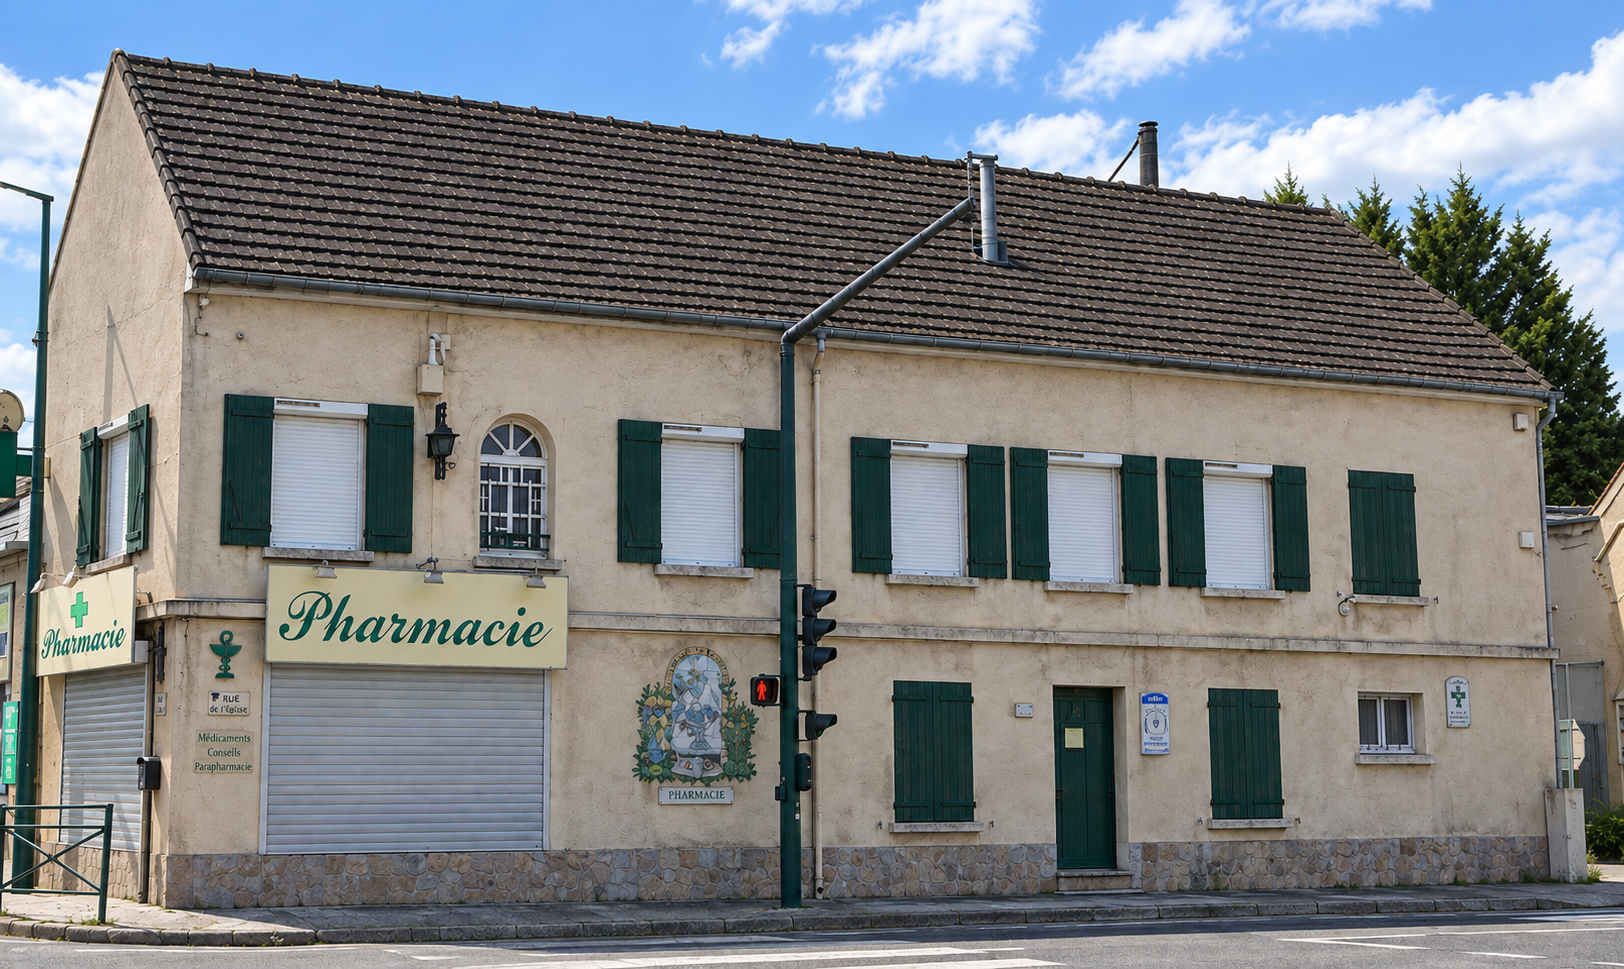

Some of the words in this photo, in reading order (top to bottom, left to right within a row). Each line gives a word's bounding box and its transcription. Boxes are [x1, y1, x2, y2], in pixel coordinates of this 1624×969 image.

[279, 590, 553, 648] Pharmacie
[41, 619, 127, 659] Pharmacie
[223, 695, 240, 703] RUE
[198, 733, 251, 743] Médicaments
[207, 748, 241, 757] Conseils
[195, 762, 252, 773] Parapharmacie
[669, 791, 725, 799] PHARMACIE
